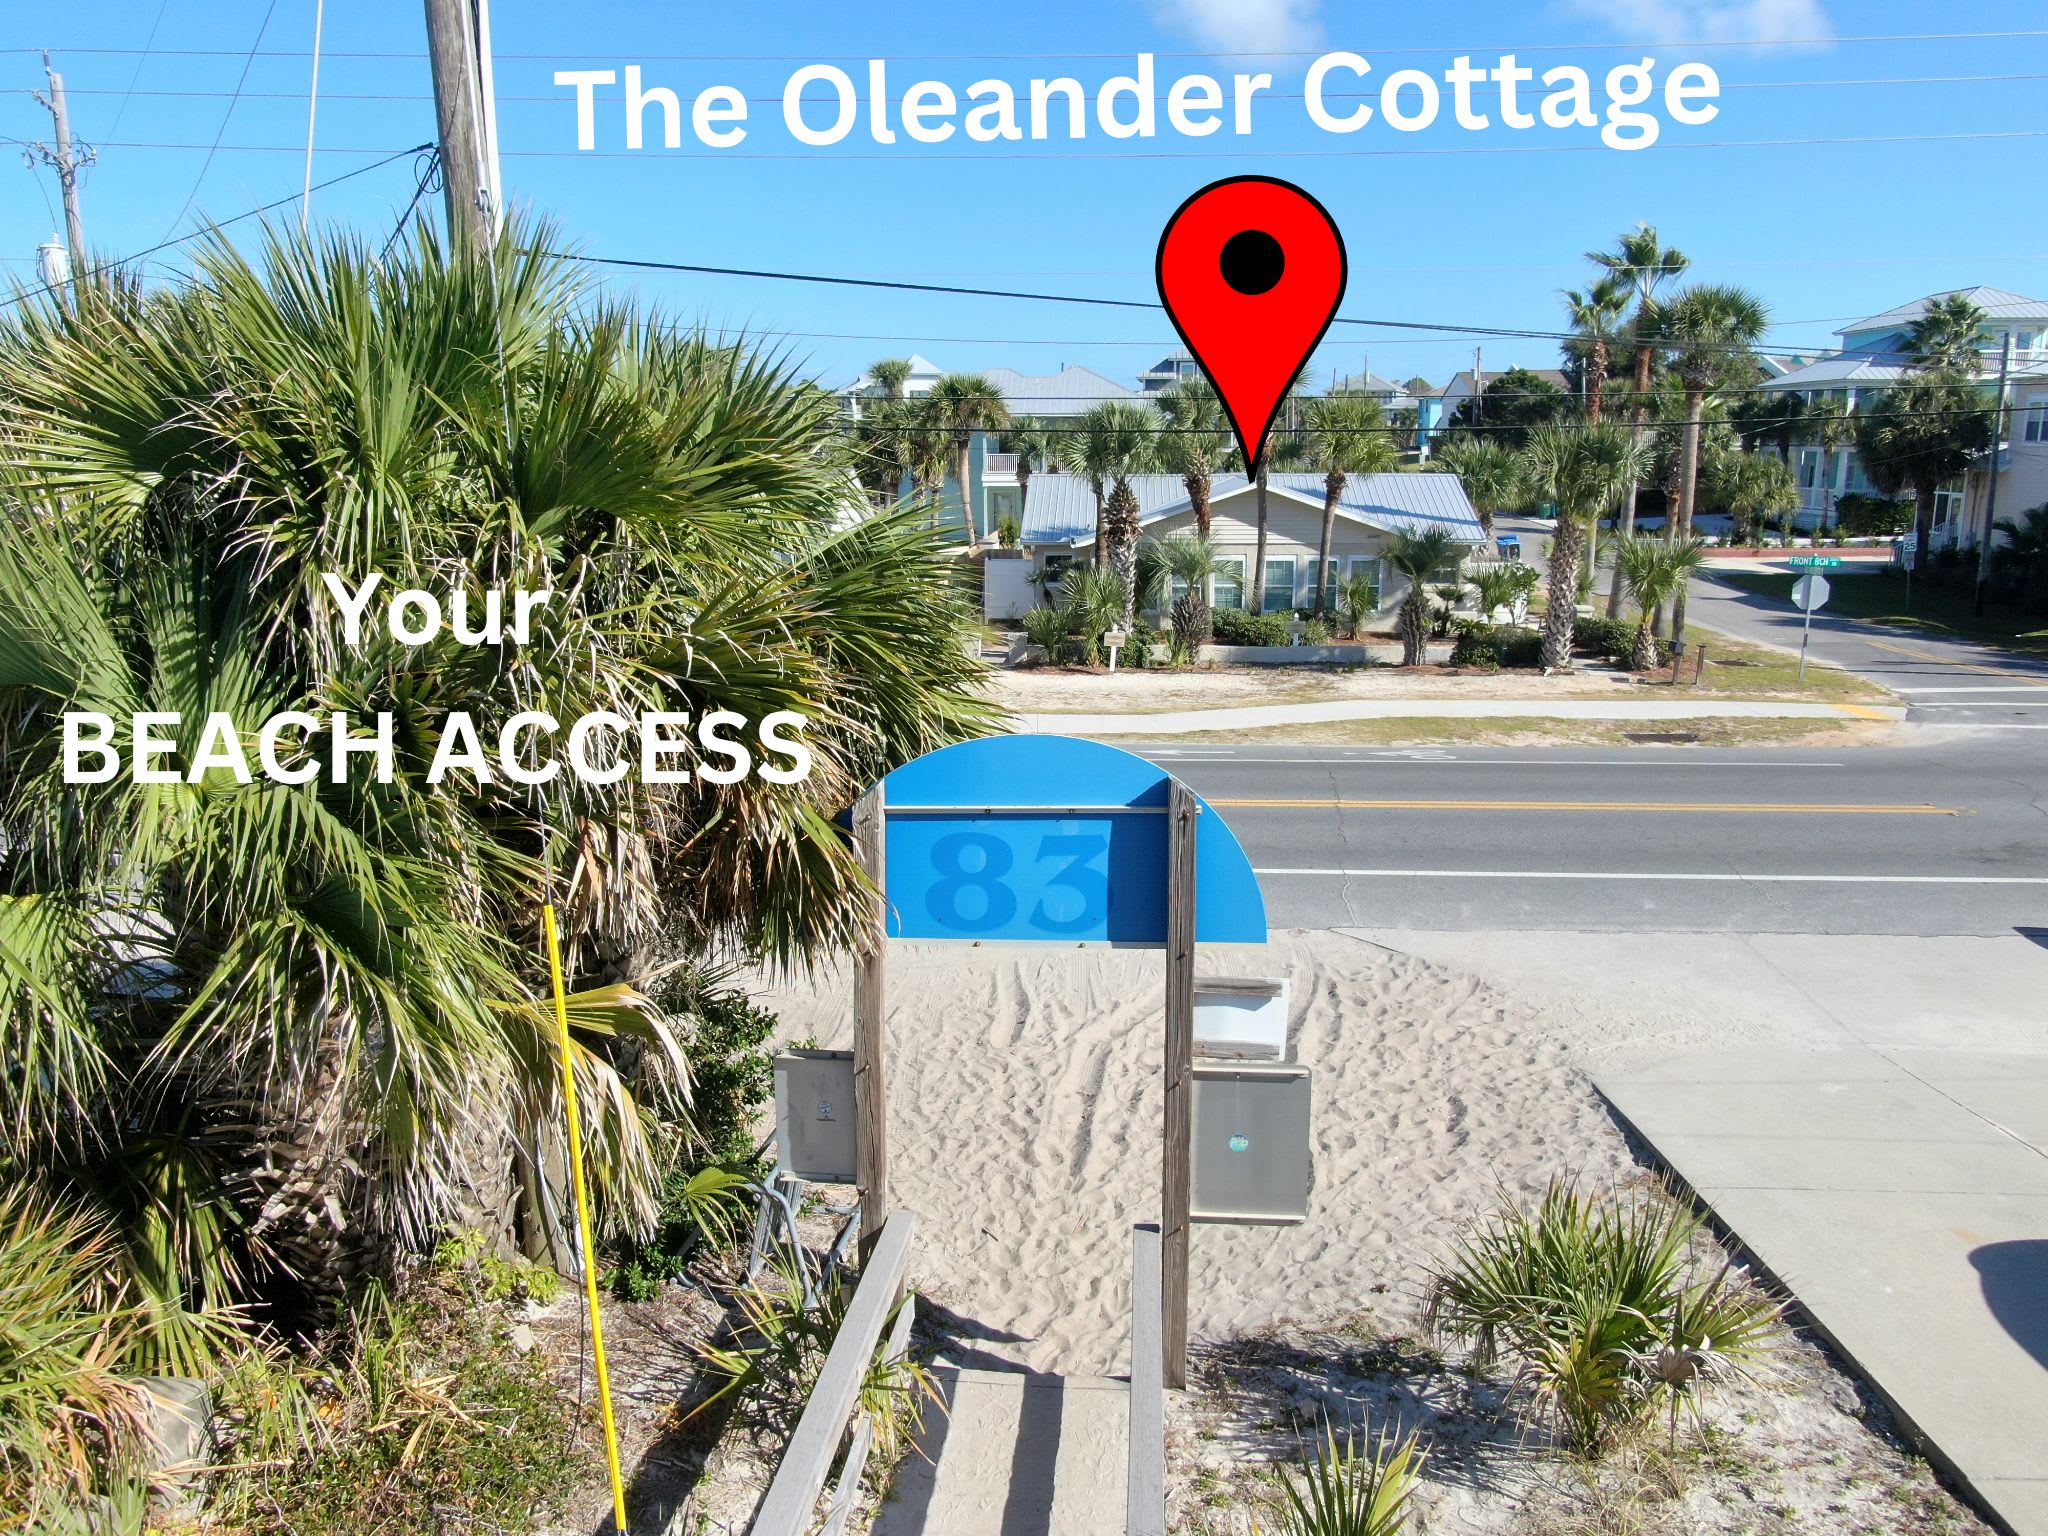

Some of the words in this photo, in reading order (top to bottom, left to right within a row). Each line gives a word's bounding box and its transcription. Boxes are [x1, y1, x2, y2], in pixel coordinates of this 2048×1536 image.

[1904, 543, 1916, 551] 25
[1789, 557, 1812, 566] FRONT
[1814, 557, 1829, 566] BCH
[924, 831, 1114, 935] 83
